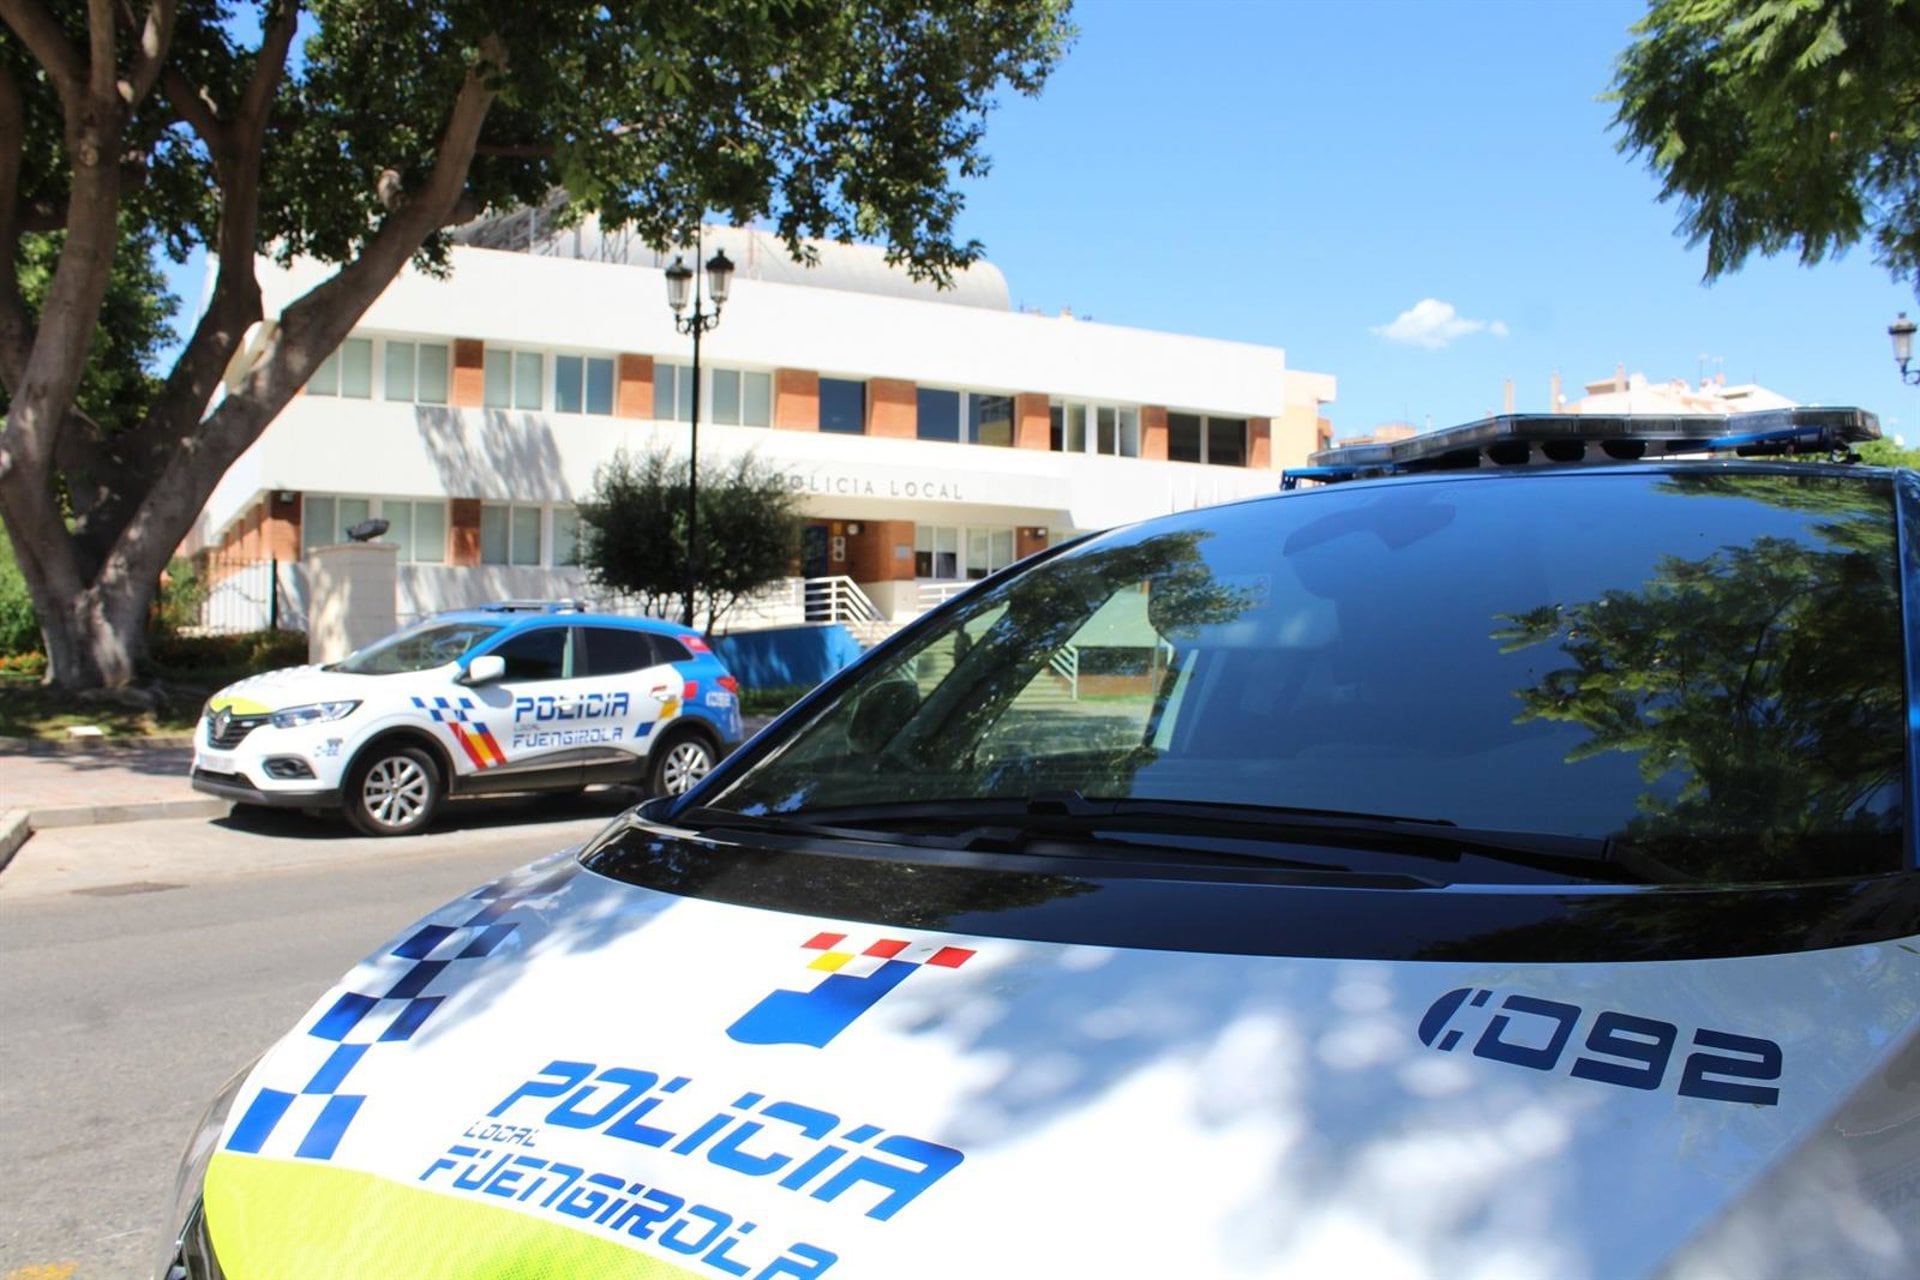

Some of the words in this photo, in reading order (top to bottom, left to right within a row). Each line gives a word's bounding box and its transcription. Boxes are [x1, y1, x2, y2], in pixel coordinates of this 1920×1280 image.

[774, 473, 874, 494] POLICIA
[890, 480, 964, 500] LOCAL
[515, 692, 630, 722] POLICIA
[513, 727, 623, 748] FUENGIROLA
[1473, 994, 1783, 1106] 092
[463, 1121, 539, 1147] LOCAL
[486, 1060, 965, 1222] POLICIA
